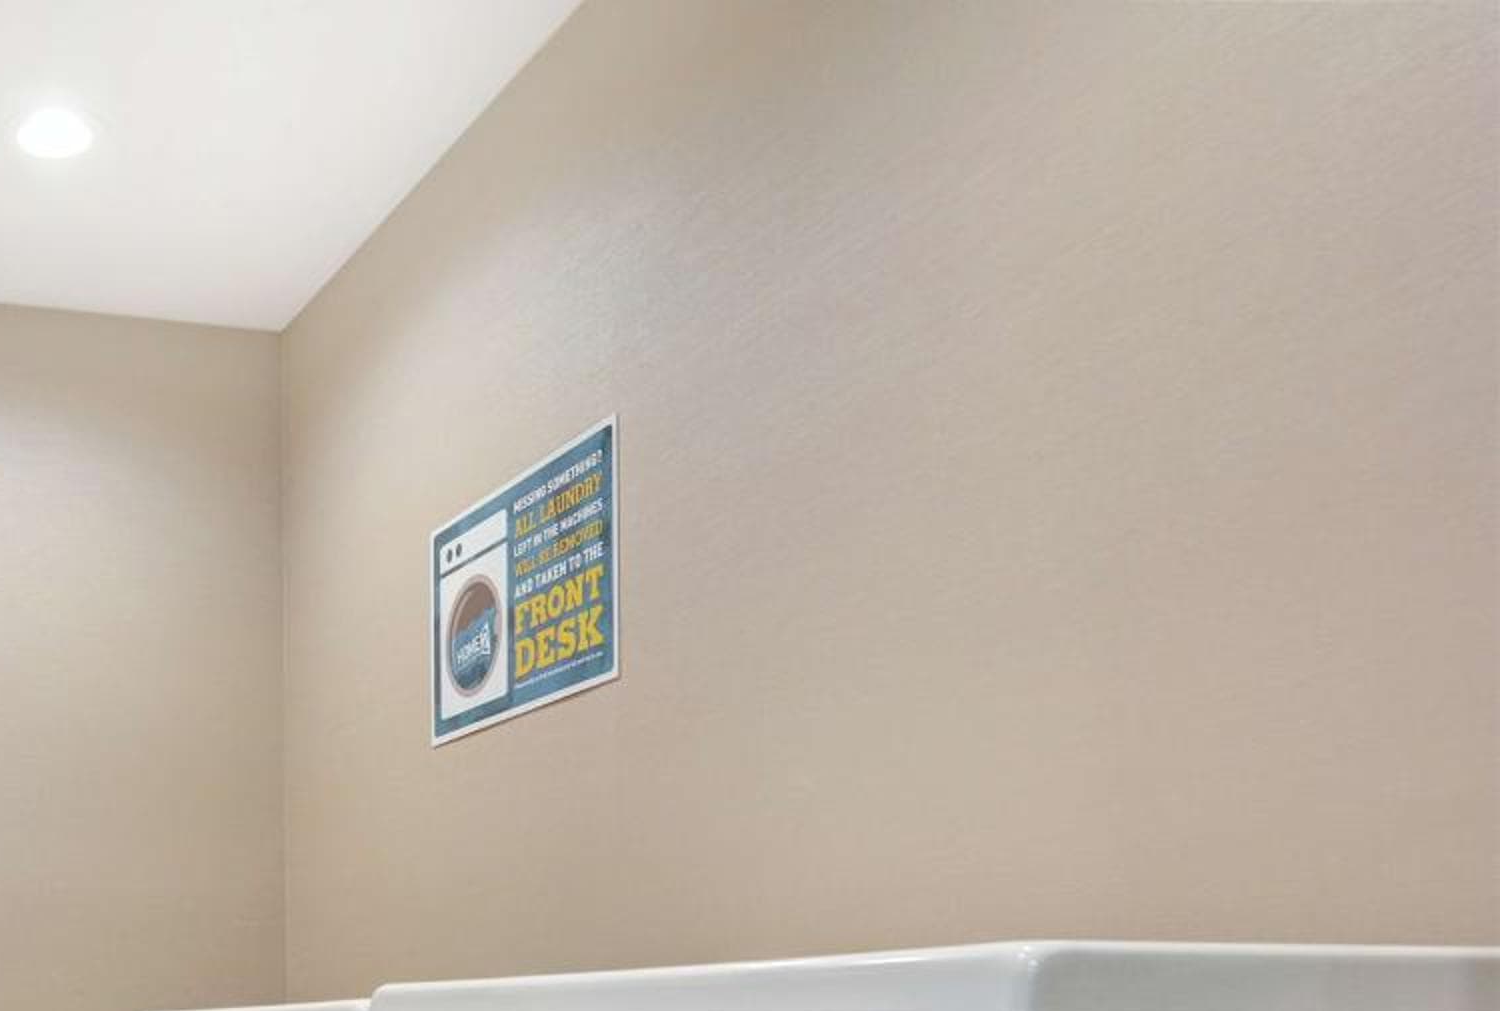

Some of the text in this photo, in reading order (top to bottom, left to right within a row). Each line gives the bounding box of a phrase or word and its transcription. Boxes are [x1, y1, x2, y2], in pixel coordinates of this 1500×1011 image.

[515, 471, 603, 538] ALL LAUNDRY
[535, 560, 567, 588] TAKEN
[569, 552, 581, 572] TO
[583, 541, 604, 564] THE
[515, 564, 603, 635] FRONT
[515, 604, 604, 682] DESK
